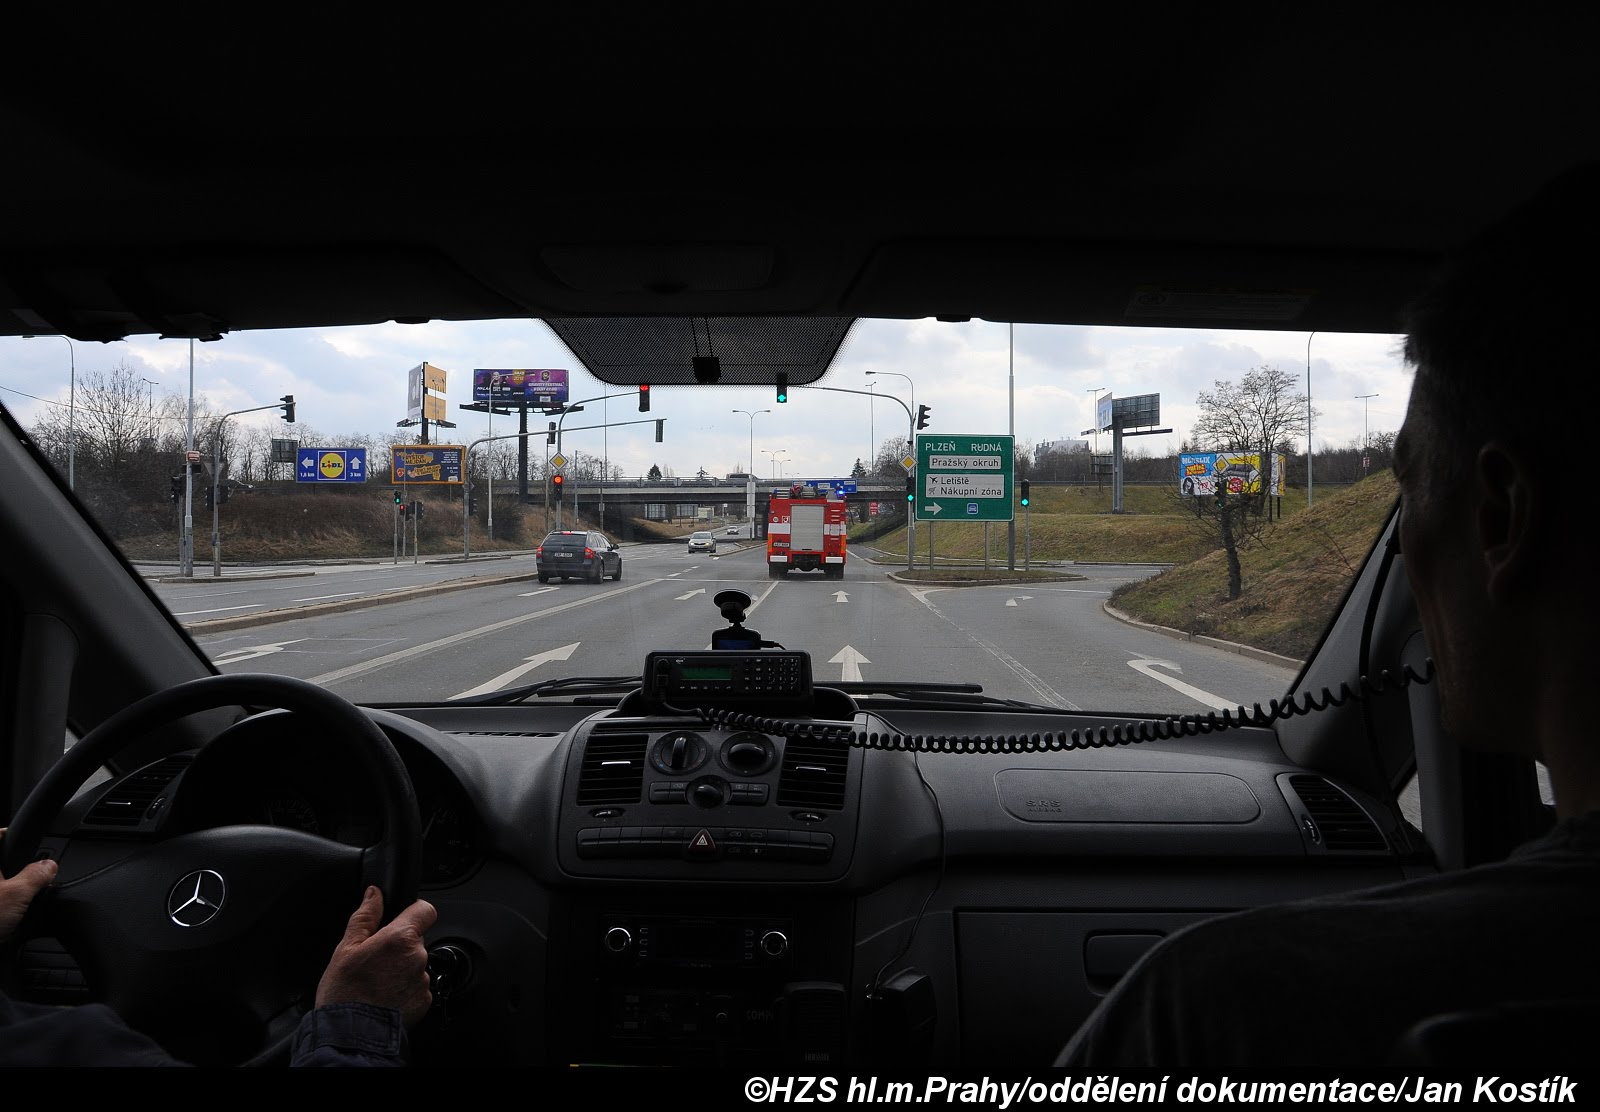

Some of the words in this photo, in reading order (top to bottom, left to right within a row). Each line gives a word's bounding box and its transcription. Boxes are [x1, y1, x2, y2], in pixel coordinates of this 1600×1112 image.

[925, 441, 956, 452] PLZEŇ
[971, 442, 1002, 452] RUDNÁ
[932, 458, 968, 468] Pražský
[973, 458, 999, 467] okruh
[941, 476, 969, 485] Letiště
[940, 487, 977, 497] Nákupní
[981, 488, 1002, 496] zóna
[1025, 800, 1061, 808] SRS
